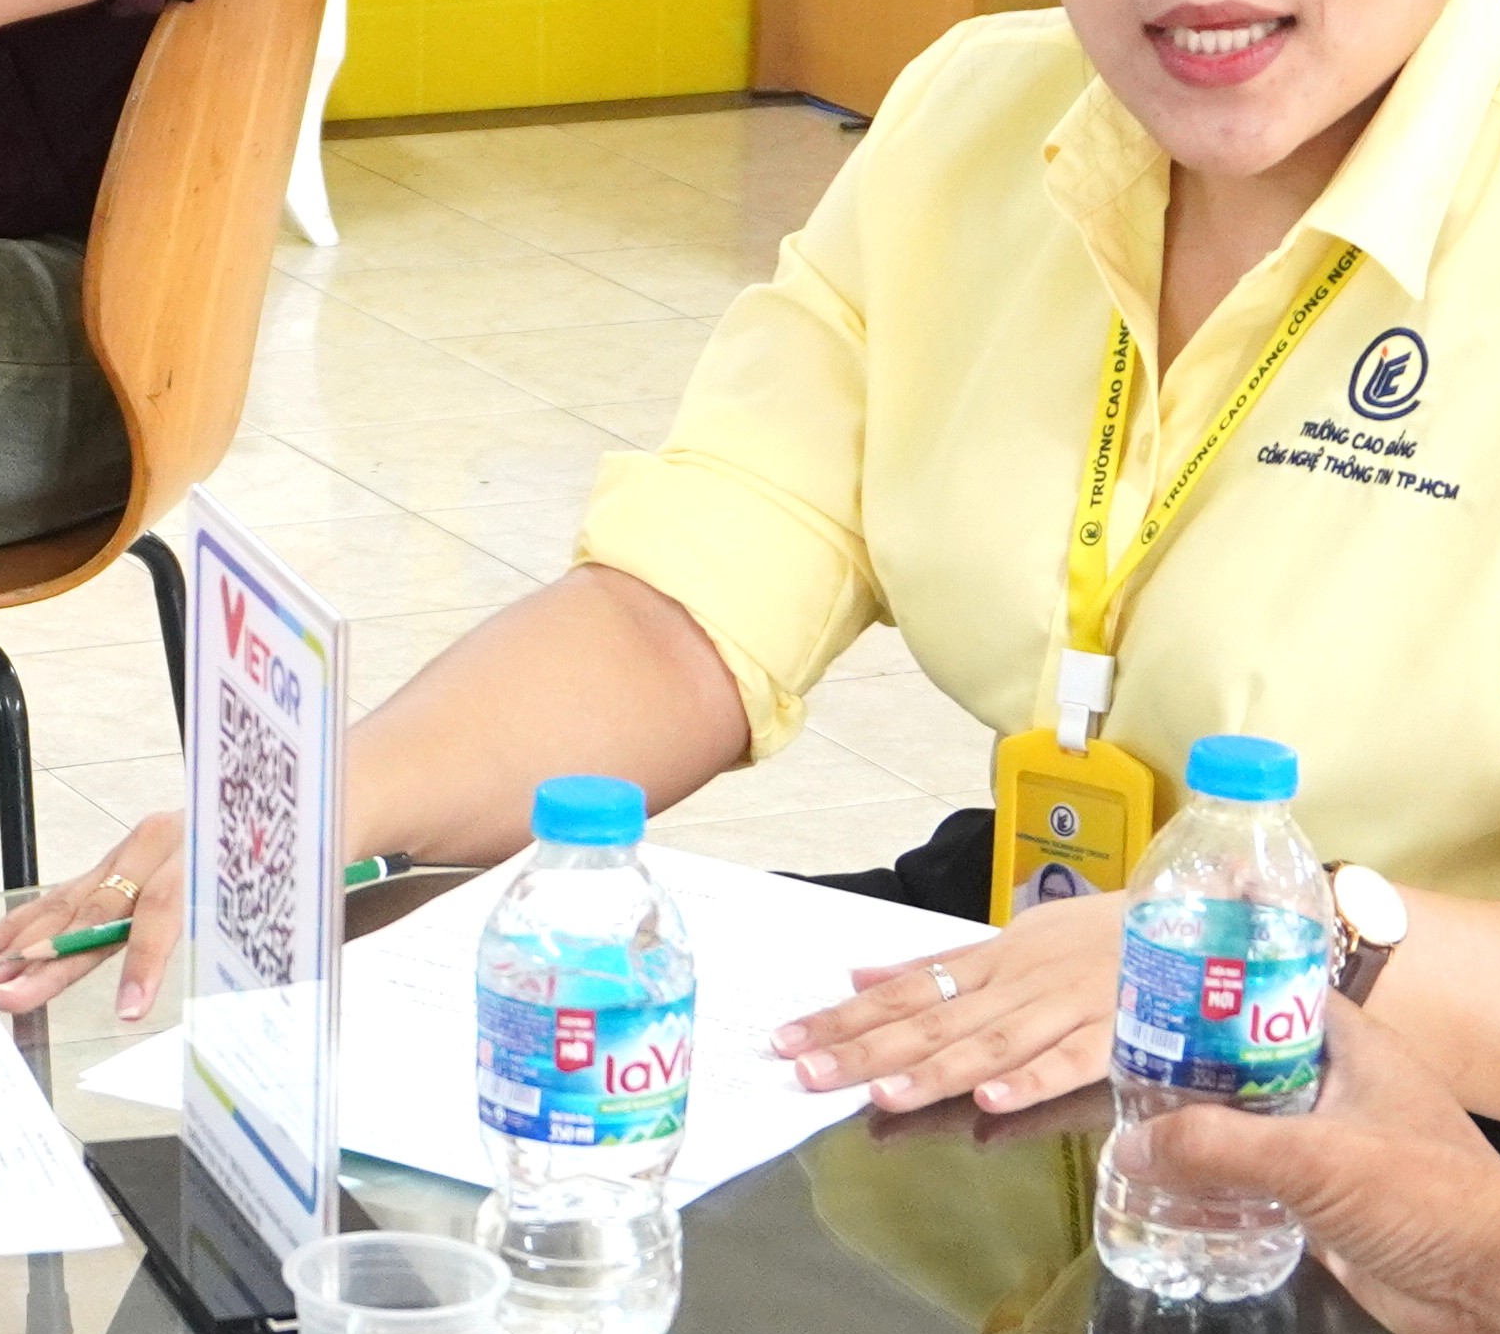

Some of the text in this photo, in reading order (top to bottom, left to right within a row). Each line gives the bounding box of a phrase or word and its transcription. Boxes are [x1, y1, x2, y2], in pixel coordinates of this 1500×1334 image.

[1218, 394, 1250, 431] CAO
[1286, 281, 1331, 337] CÔNG
[1105, 379, 1125, 420] CAO
[1352, 431, 1385, 454] CAO
[1324, 455, 1374, 483] THÔNG
[1249, 992, 1328, 1045] laV
